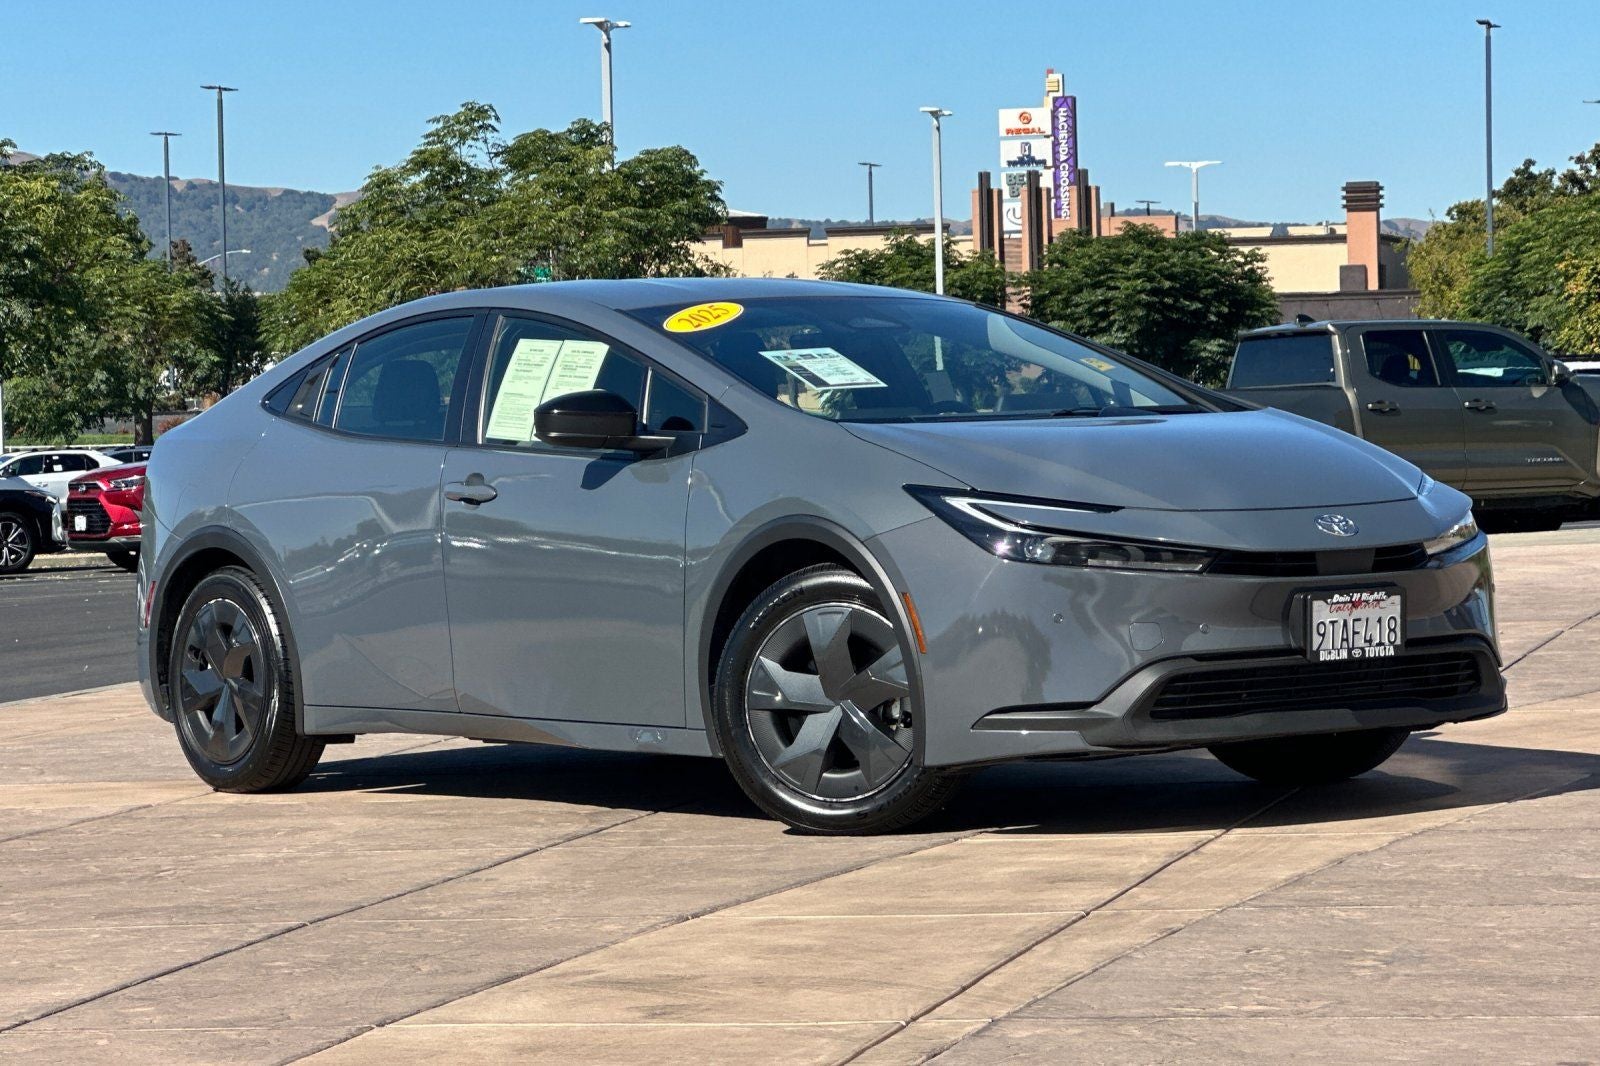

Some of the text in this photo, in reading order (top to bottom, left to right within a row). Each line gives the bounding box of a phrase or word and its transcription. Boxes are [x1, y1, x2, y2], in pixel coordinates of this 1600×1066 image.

[1005, 127, 1046, 135] REGAL
[1058, 107, 1070, 219] HACIENDA CROSSING
[678, 304, 729, 329] 2025
[1316, 615, 1398, 651] 9TAF418
[1319, 645, 1395, 661] DUBLIN TOYOTA
